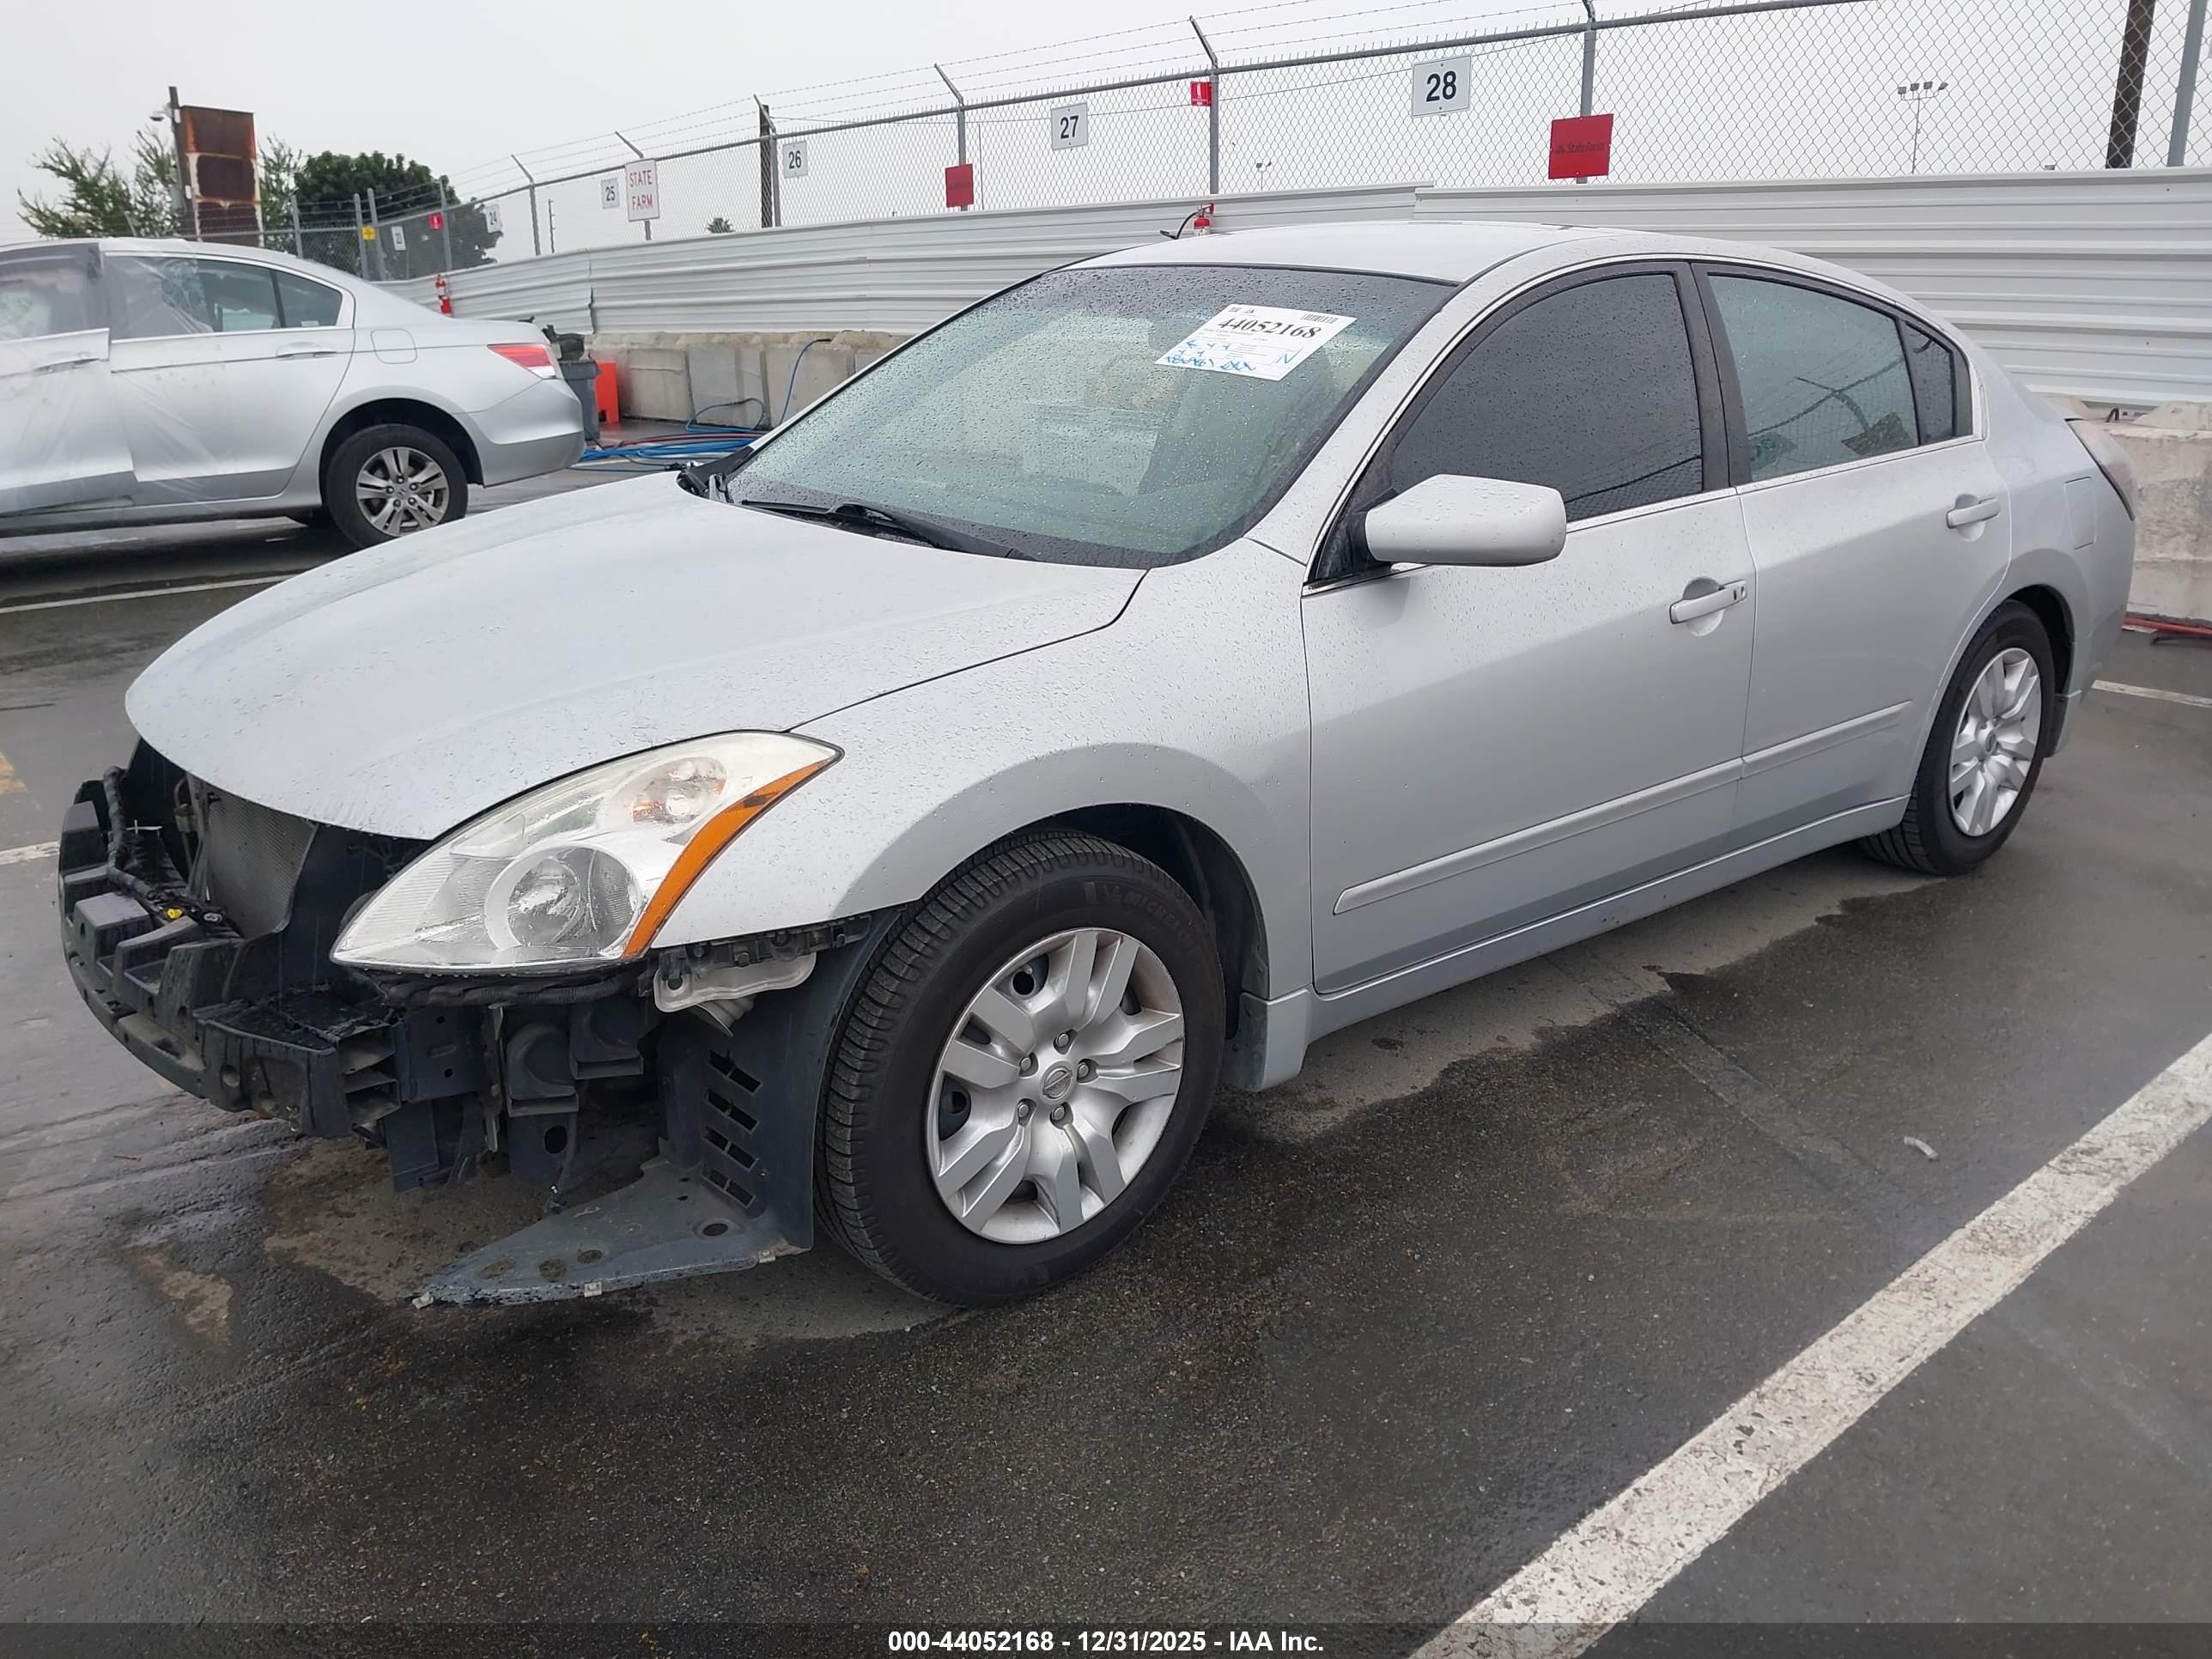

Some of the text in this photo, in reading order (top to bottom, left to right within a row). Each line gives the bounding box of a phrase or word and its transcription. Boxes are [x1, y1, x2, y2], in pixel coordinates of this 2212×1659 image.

[1426, 70, 1456, 102] 28
[1060, 114, 1079, 139] 27
[788, 150, 801, 169] 26
[629, 169, 653, 187] STATE
[605, 185, 616, 202] 25
[631, 193, 653, 211] FARM
[1218, 318, 1322, 338] 44052168
